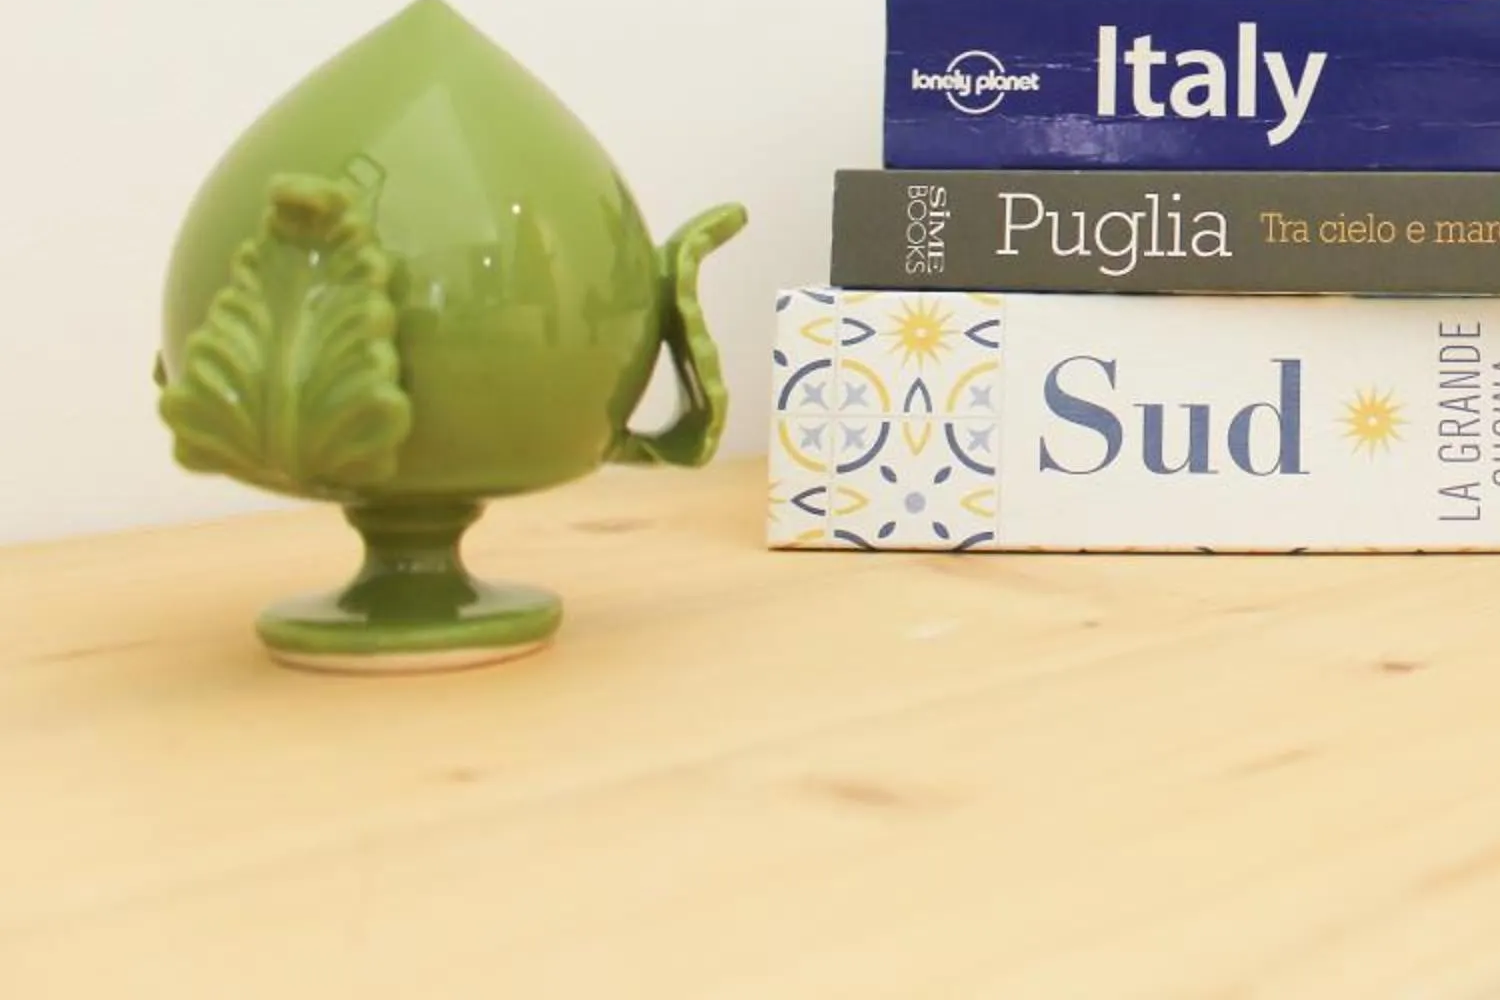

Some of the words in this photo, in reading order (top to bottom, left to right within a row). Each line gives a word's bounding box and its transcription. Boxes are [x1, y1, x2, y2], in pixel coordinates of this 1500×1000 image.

[912, 68, 971, 97] lonely
[975, 69, 1041, 96] planet
[1097, 22, 1329, 147] Italy
[905, 185, 928, 275] BOOKS
[996, 192, 1233, 276] Puglia
[1259, 212, 1310, 243] Tra
[1319, 213, 1396, 243] cielo
[1406, 220, 1426, 243] e
[1039, 355, 1311, 477] Sud
[1438, 321, 1481, 463] GRANDE
[1438, 481, 1481, 521] LA
